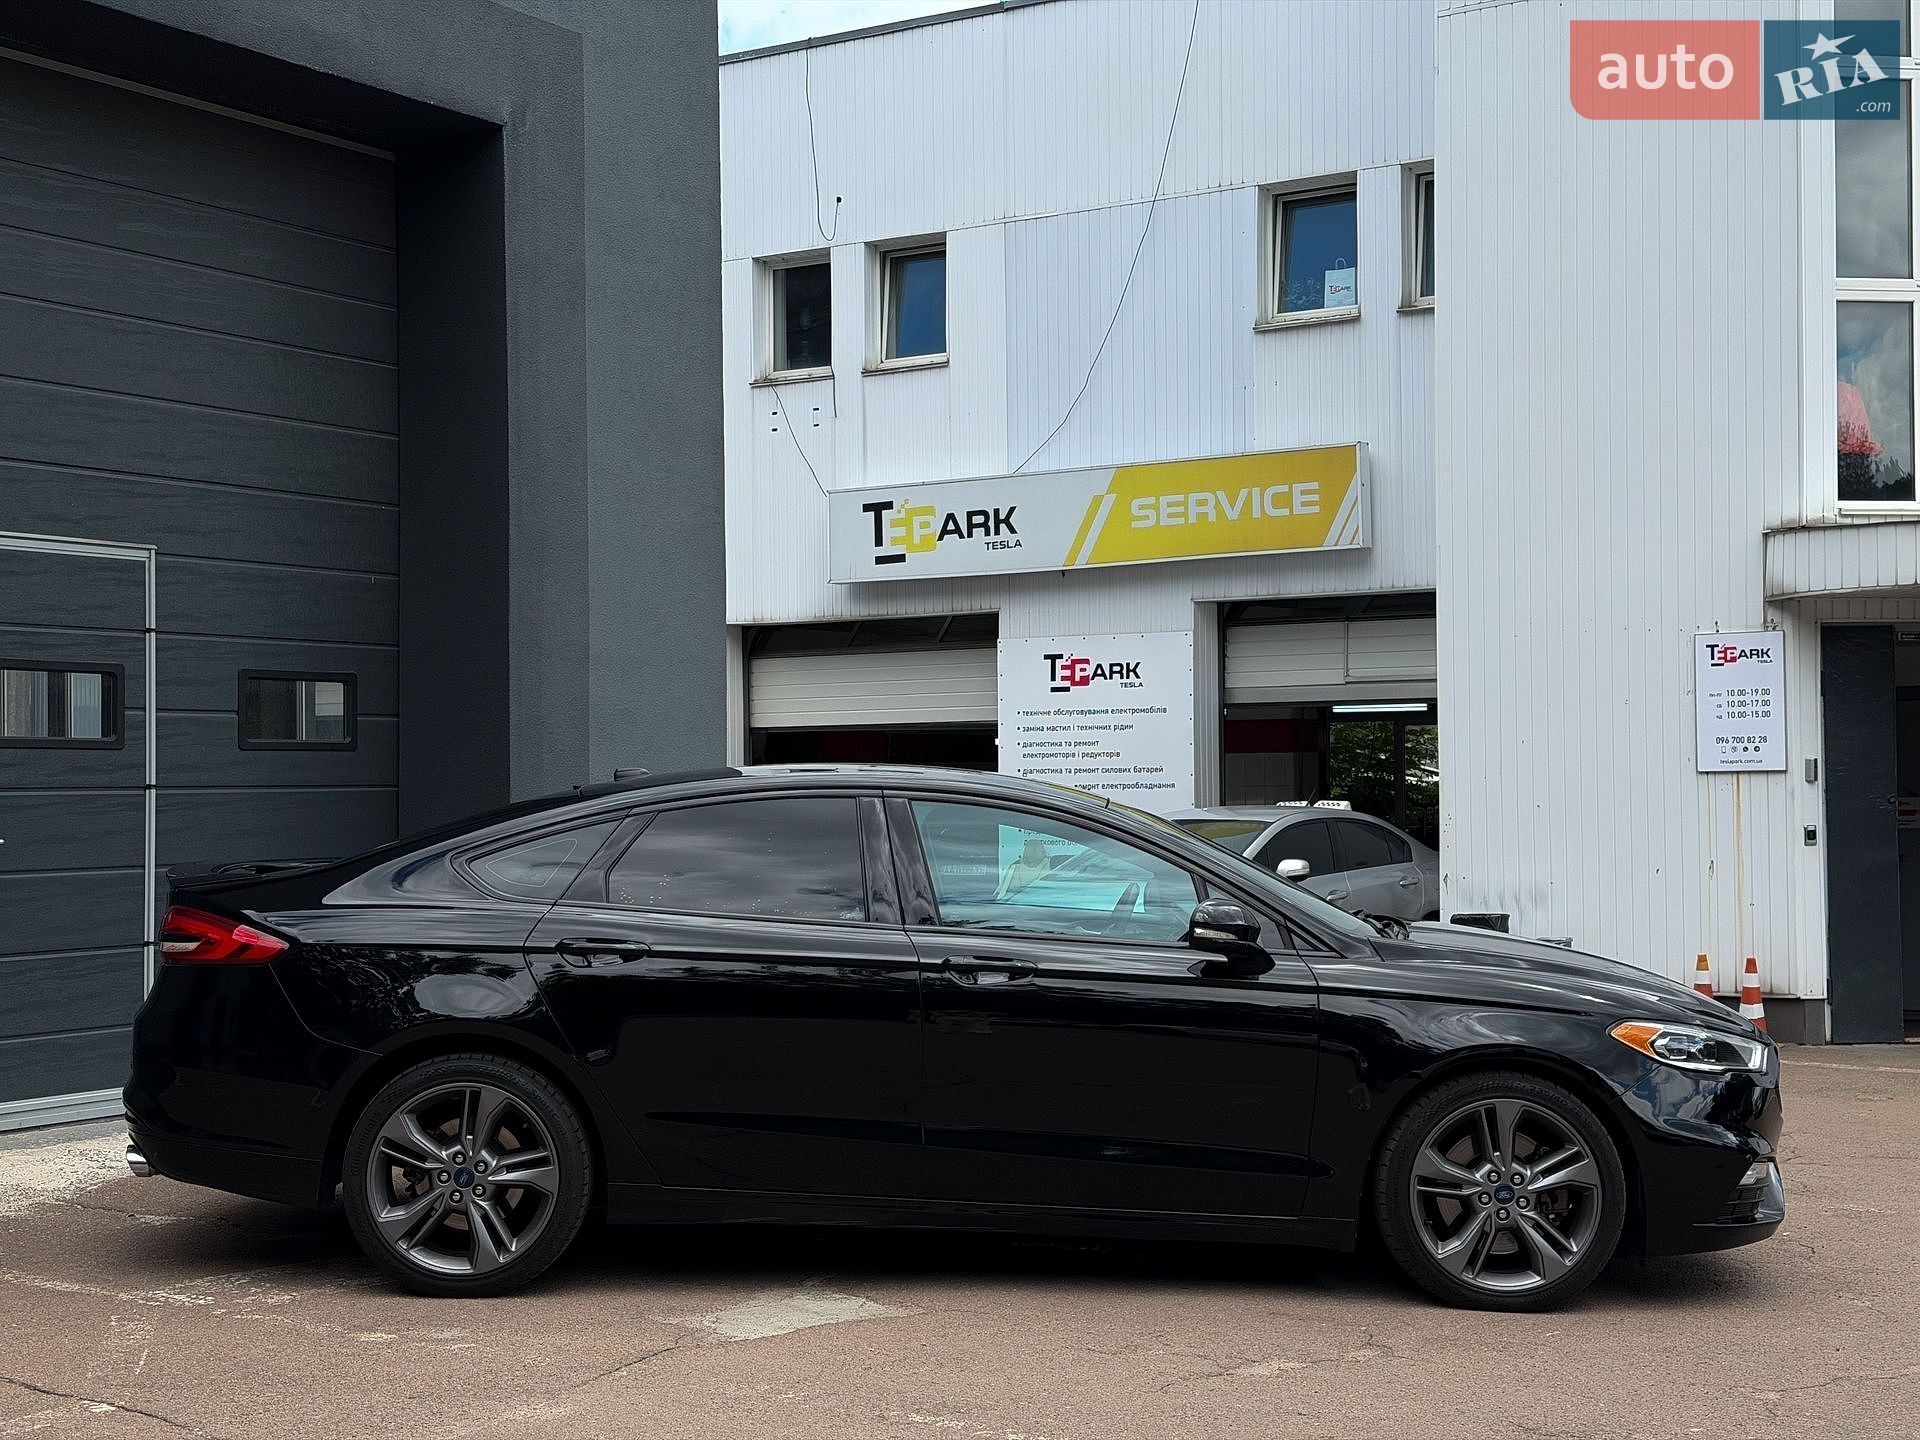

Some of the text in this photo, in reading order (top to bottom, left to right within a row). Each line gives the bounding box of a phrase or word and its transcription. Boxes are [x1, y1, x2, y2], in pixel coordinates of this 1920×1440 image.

[1131, 482, 1320, 528] SERVICE
[984, 539, 1023, 551] TESLA
[1727, 688, 1771, 697] 10.00-19.00
[1727, 699, 1771, 708] 10.00-17.00
[1053, 707, 1109, 717] обслуговування
[1110, 706, 1167, 715] електромобілів
[1727, 710, 1771, 719] 10.00-15.00
[1076, 723, 1111, 731] технічних
[1022, 740, 1062, 748] діагностика
[1074, 740, 1099, 748] ремонт
[1022, 751, 1076, 759] електромоторів
[1081, 750, 1121, 759] редукторів
[1022, 767, 1062, 777] діагностика
[1074, 766, 1099, 776] ремонт
[1133, 765, 1164, 775] батарей
[1074, 781, 1176, 791] монт електрообладнання
